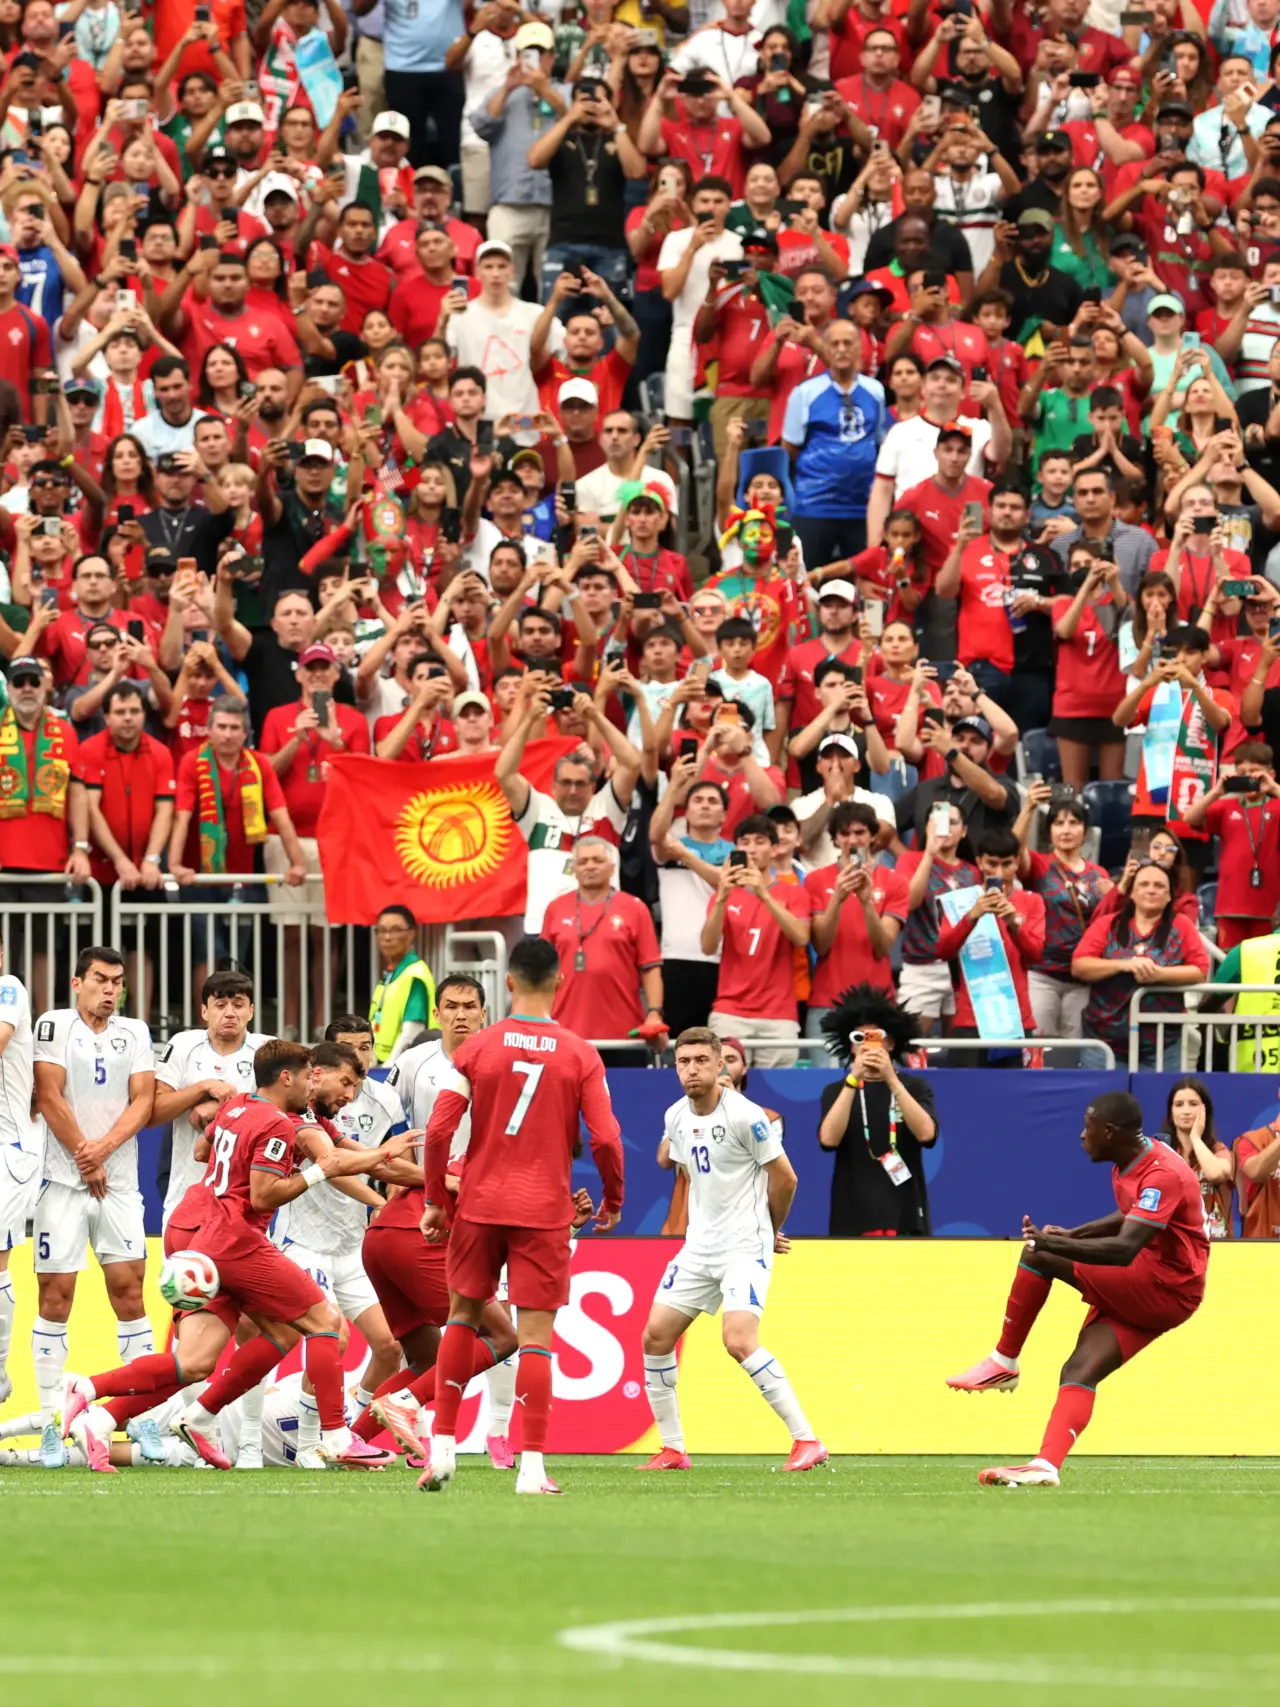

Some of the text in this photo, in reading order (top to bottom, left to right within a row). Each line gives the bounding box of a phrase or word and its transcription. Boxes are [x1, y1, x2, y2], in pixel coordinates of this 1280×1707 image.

[751, 319, 761, 340] 7
[1084, 630, 1097, 657] 7
[749, 928, 762, 956] 7
[504, 1031, 557, 1053] RONALDO
[95, 1057, 107, 1086] 5
[503, 1059, 545, 1136] 7
[691, 1145, 711, 1174] 13
[38, 1231, 51, 1261] 5
